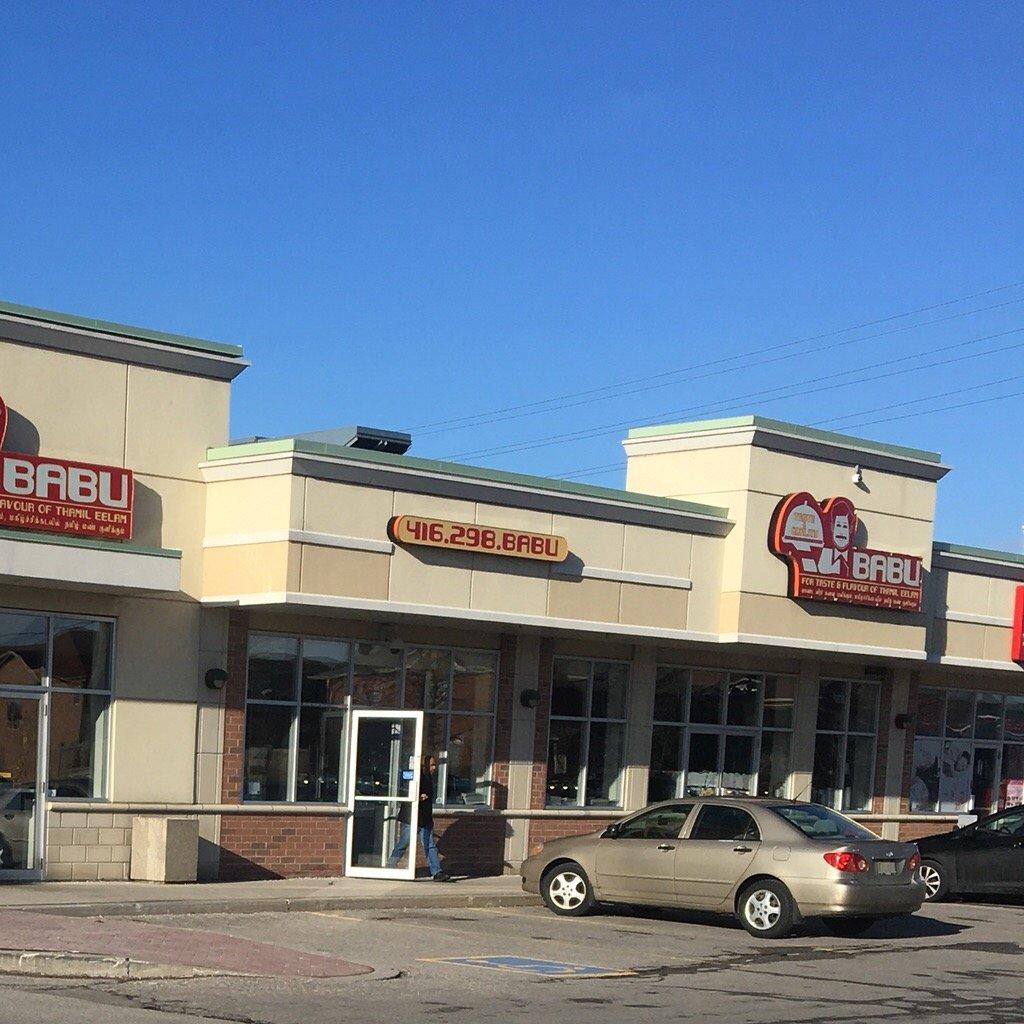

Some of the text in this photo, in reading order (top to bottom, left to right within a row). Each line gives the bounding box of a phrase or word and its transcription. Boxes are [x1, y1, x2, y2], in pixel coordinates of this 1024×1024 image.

[3, 457, 128, 508] BABU
[38, 504, 52, 514] OF
[56, 506, 92, 520] THAMIL
[95, 511, 127, 523] EELAM
[406, 520, 558, 557] 416.298.BABU
[853, 552, 920, 587] BABU
